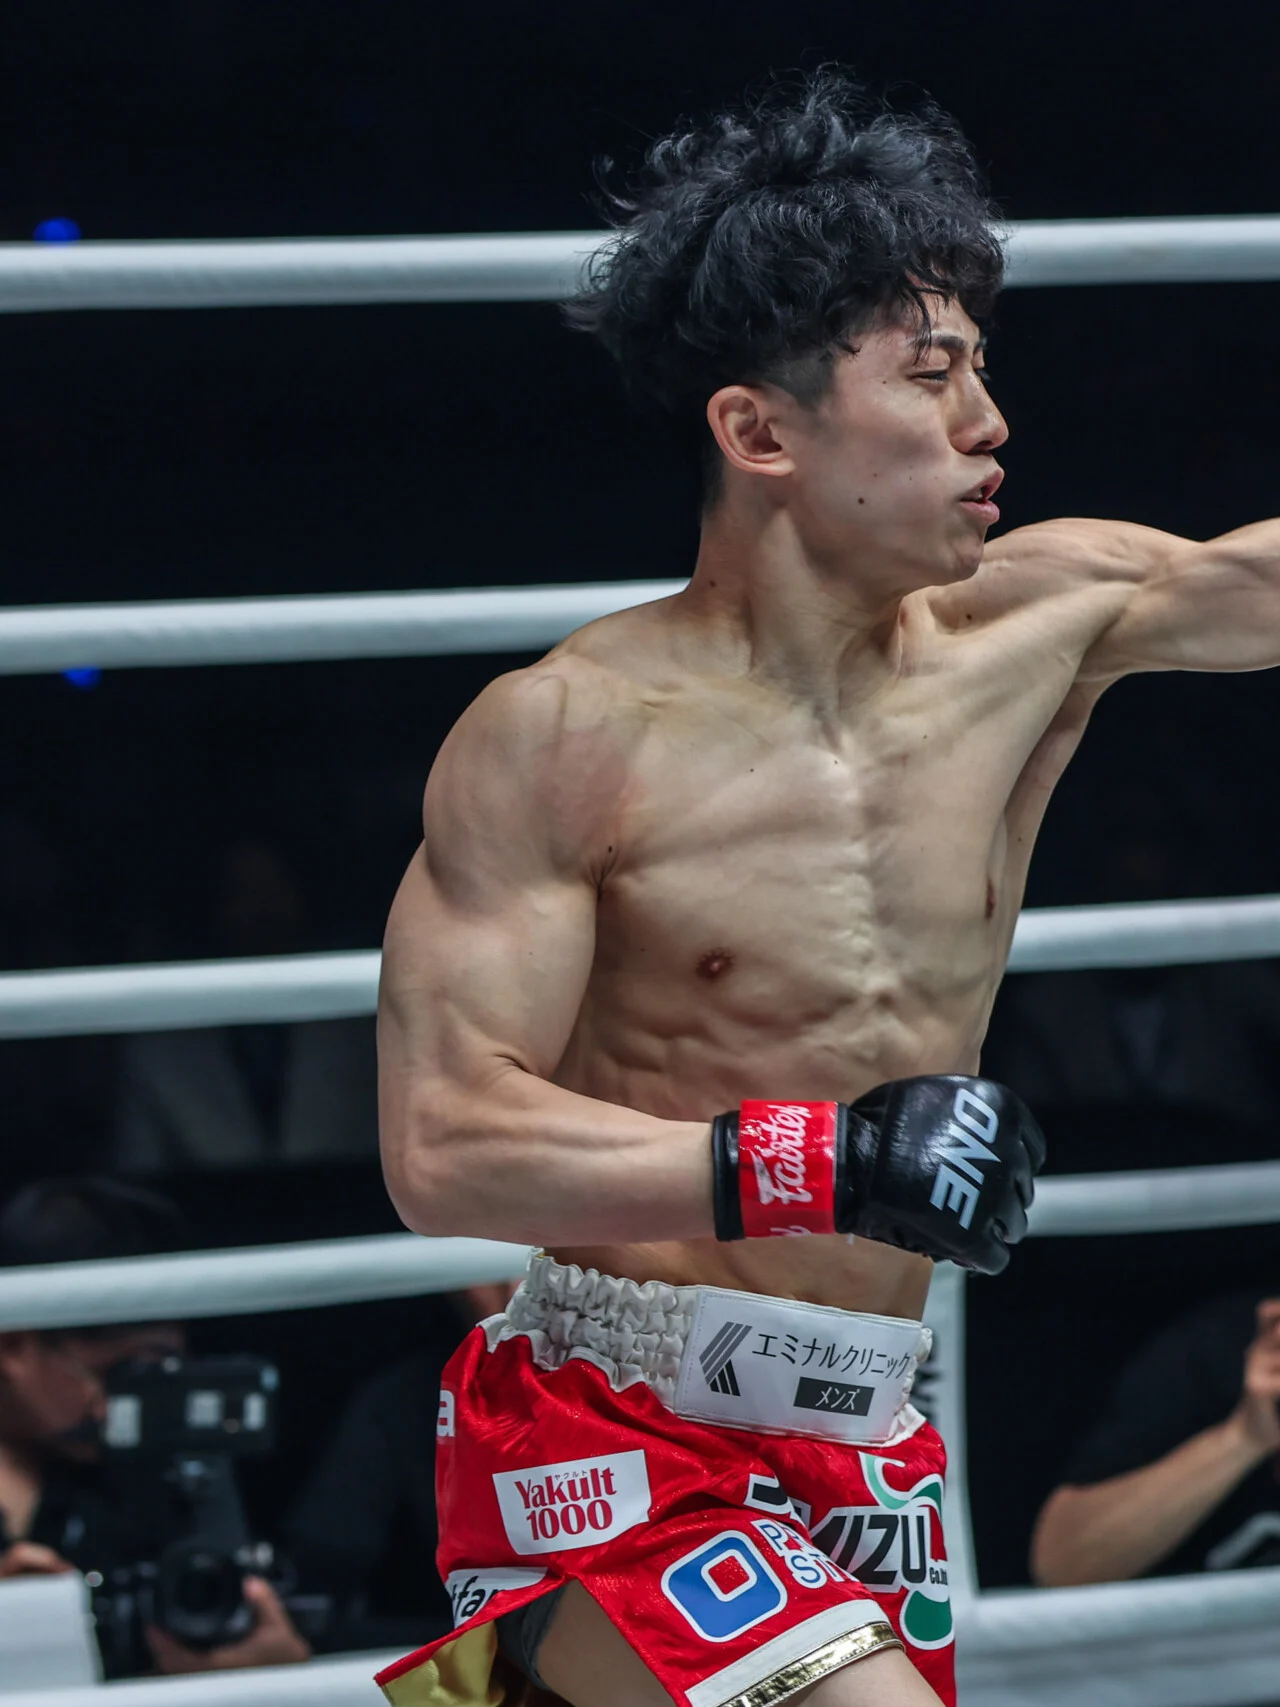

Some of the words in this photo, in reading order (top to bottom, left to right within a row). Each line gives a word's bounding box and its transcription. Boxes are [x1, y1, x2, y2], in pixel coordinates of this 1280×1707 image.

[751, 1103, 813, 1205] Fairtex
[930, 1087, 1001, 1230] ONE
[752, 1333, 911, 1379] エミナルクリニック
[815, 1386, 860, 1411] メンズ
[514, 1467, 617, 1509] Yakult
[554, 1470, 587, 1480] ヤクルト
[526, 1499, 613, 1540] 1000
